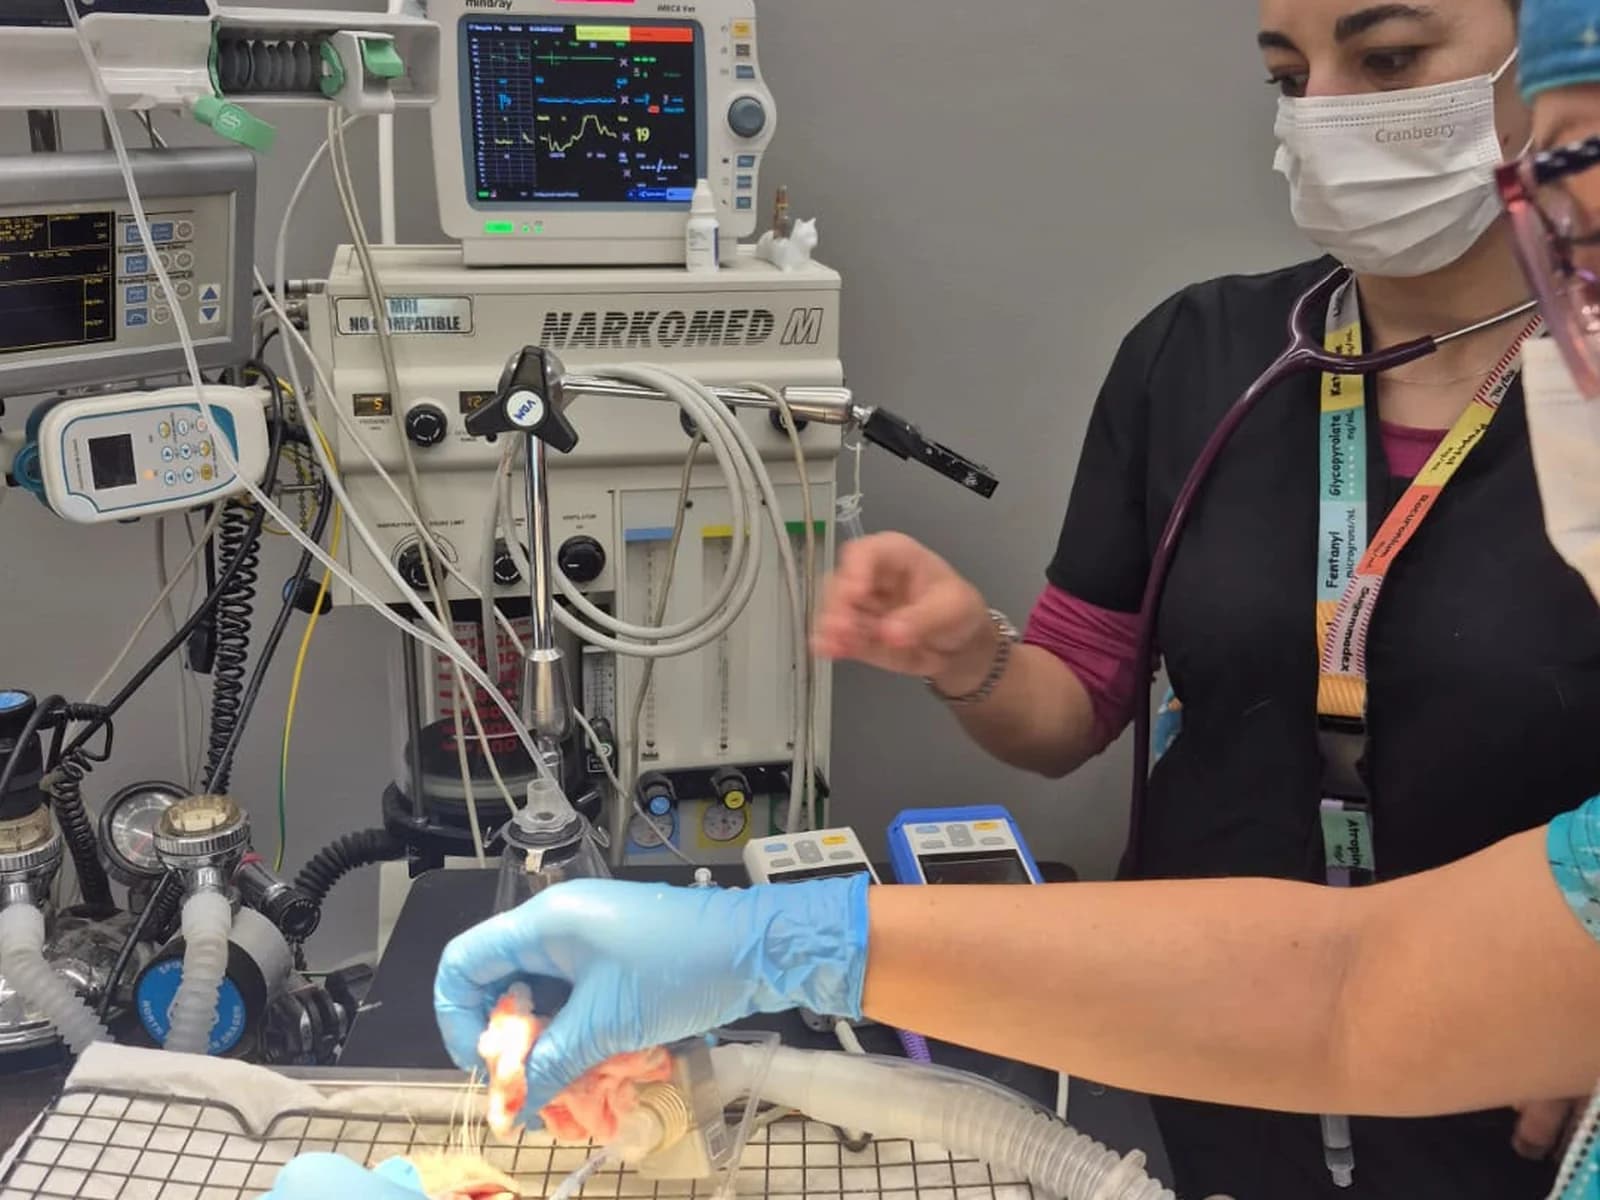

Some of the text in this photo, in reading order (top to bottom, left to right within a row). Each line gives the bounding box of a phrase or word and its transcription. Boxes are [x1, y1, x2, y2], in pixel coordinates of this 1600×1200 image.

[636, 127, 650, 142] 19
[1375, 124, 1455, 143] Cranberry
[390, 299, 418, 313] MRI
[540, 307, 824, 348] NARKOMED M
[1325, 531, 1343, 589] Fentanyl
[1341, 586, 1370, 672] Sugammadex
[1346, 818, 1363, 866] Atropin
